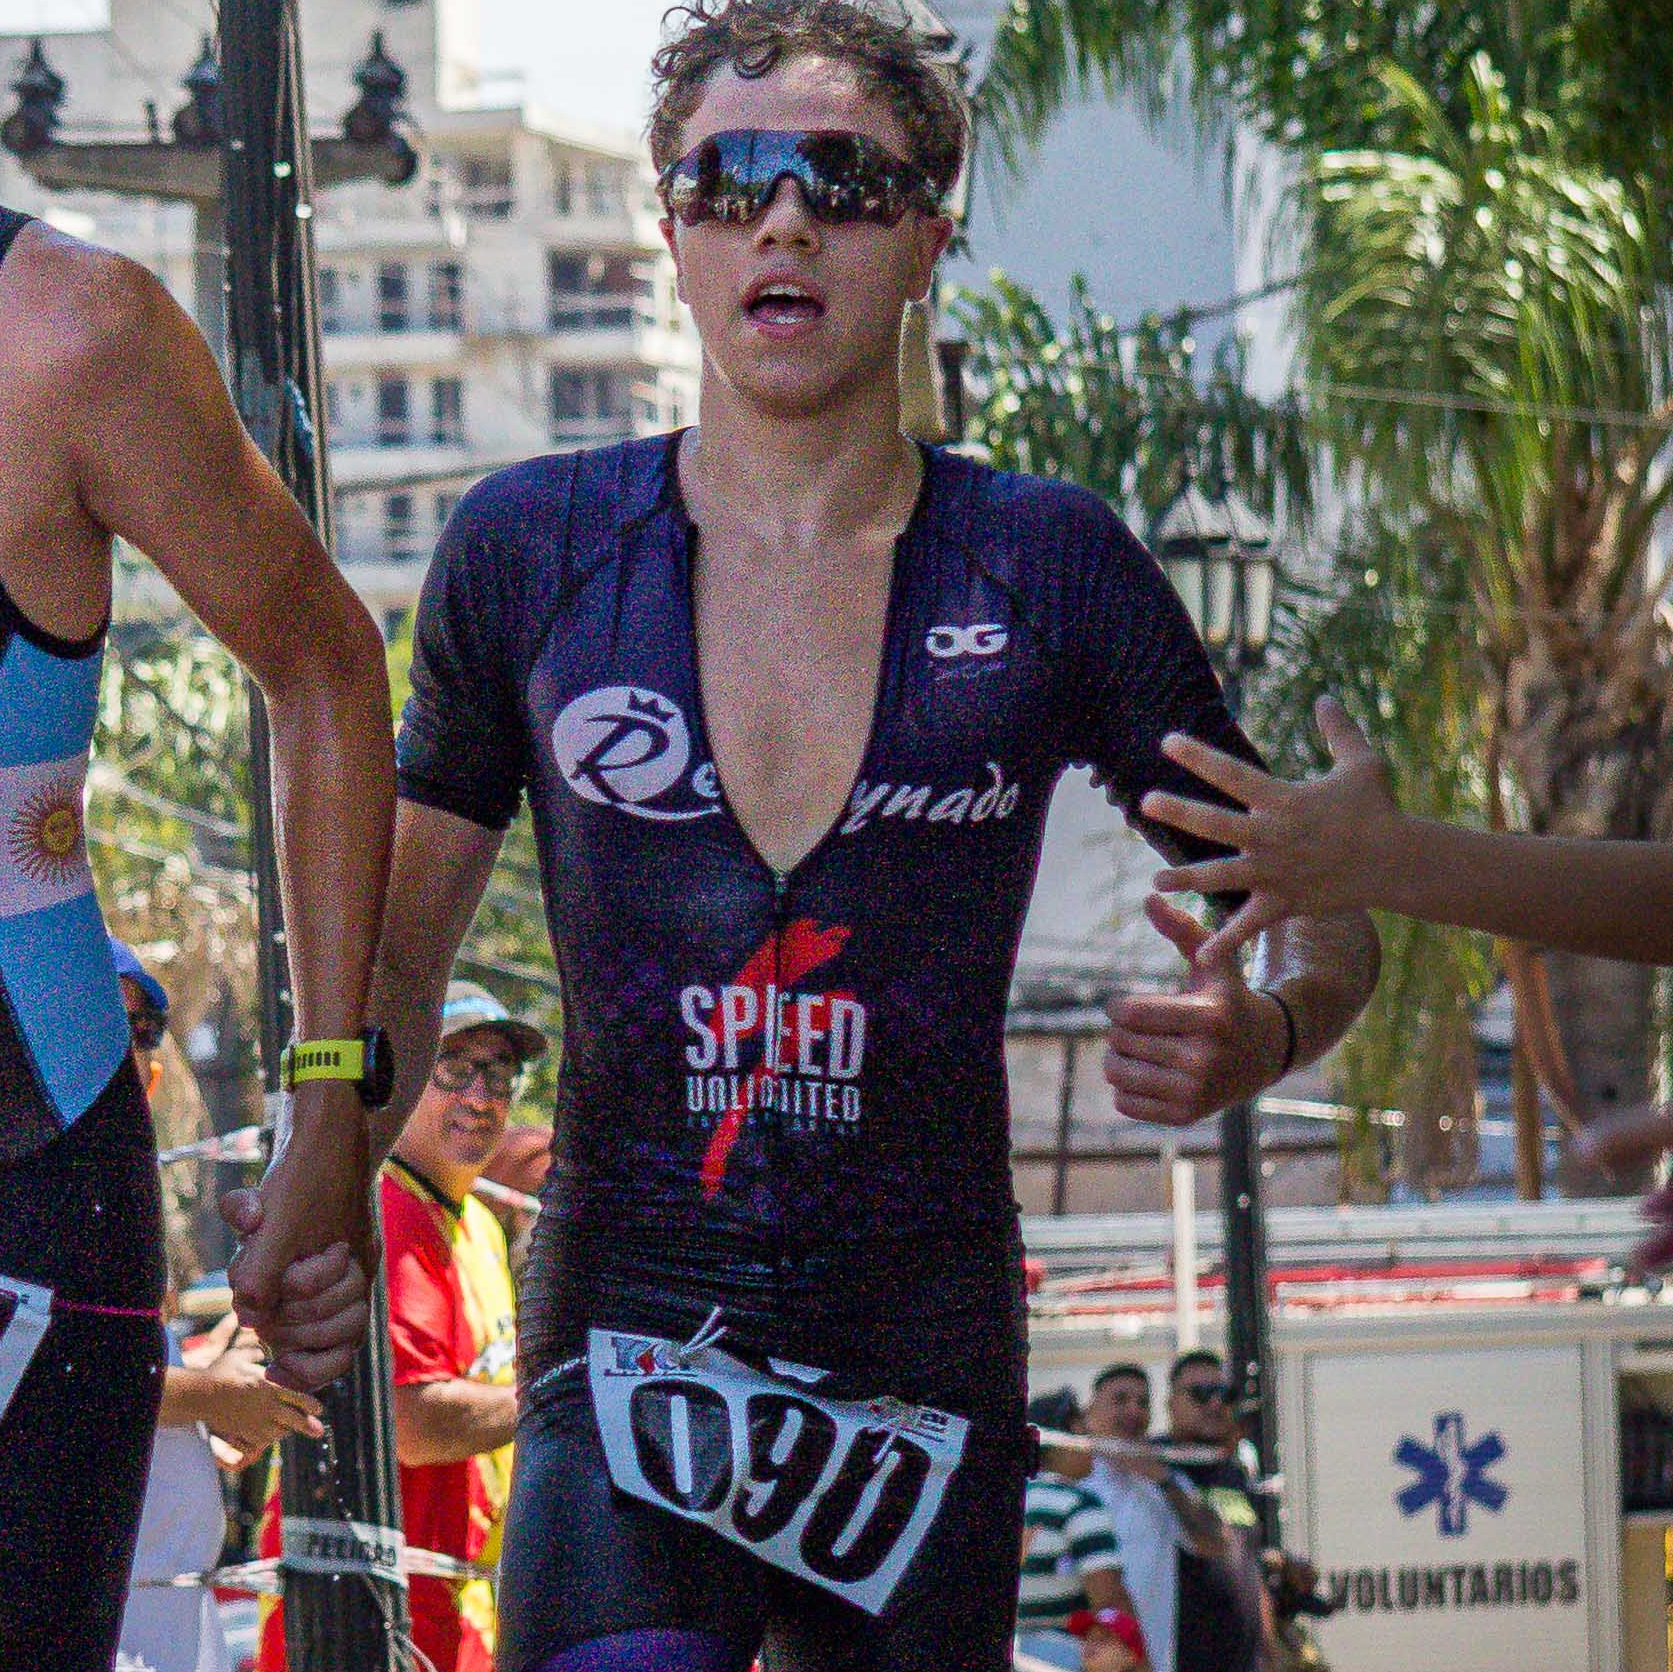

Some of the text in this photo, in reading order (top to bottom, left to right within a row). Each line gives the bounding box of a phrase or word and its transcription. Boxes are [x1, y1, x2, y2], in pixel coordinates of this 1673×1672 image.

[680, 984, 865, 1079] SPEED
[630, 1378, 931, 1584] 090
[1329, 1558, 1579, 1611] VOLUNTARIOS
